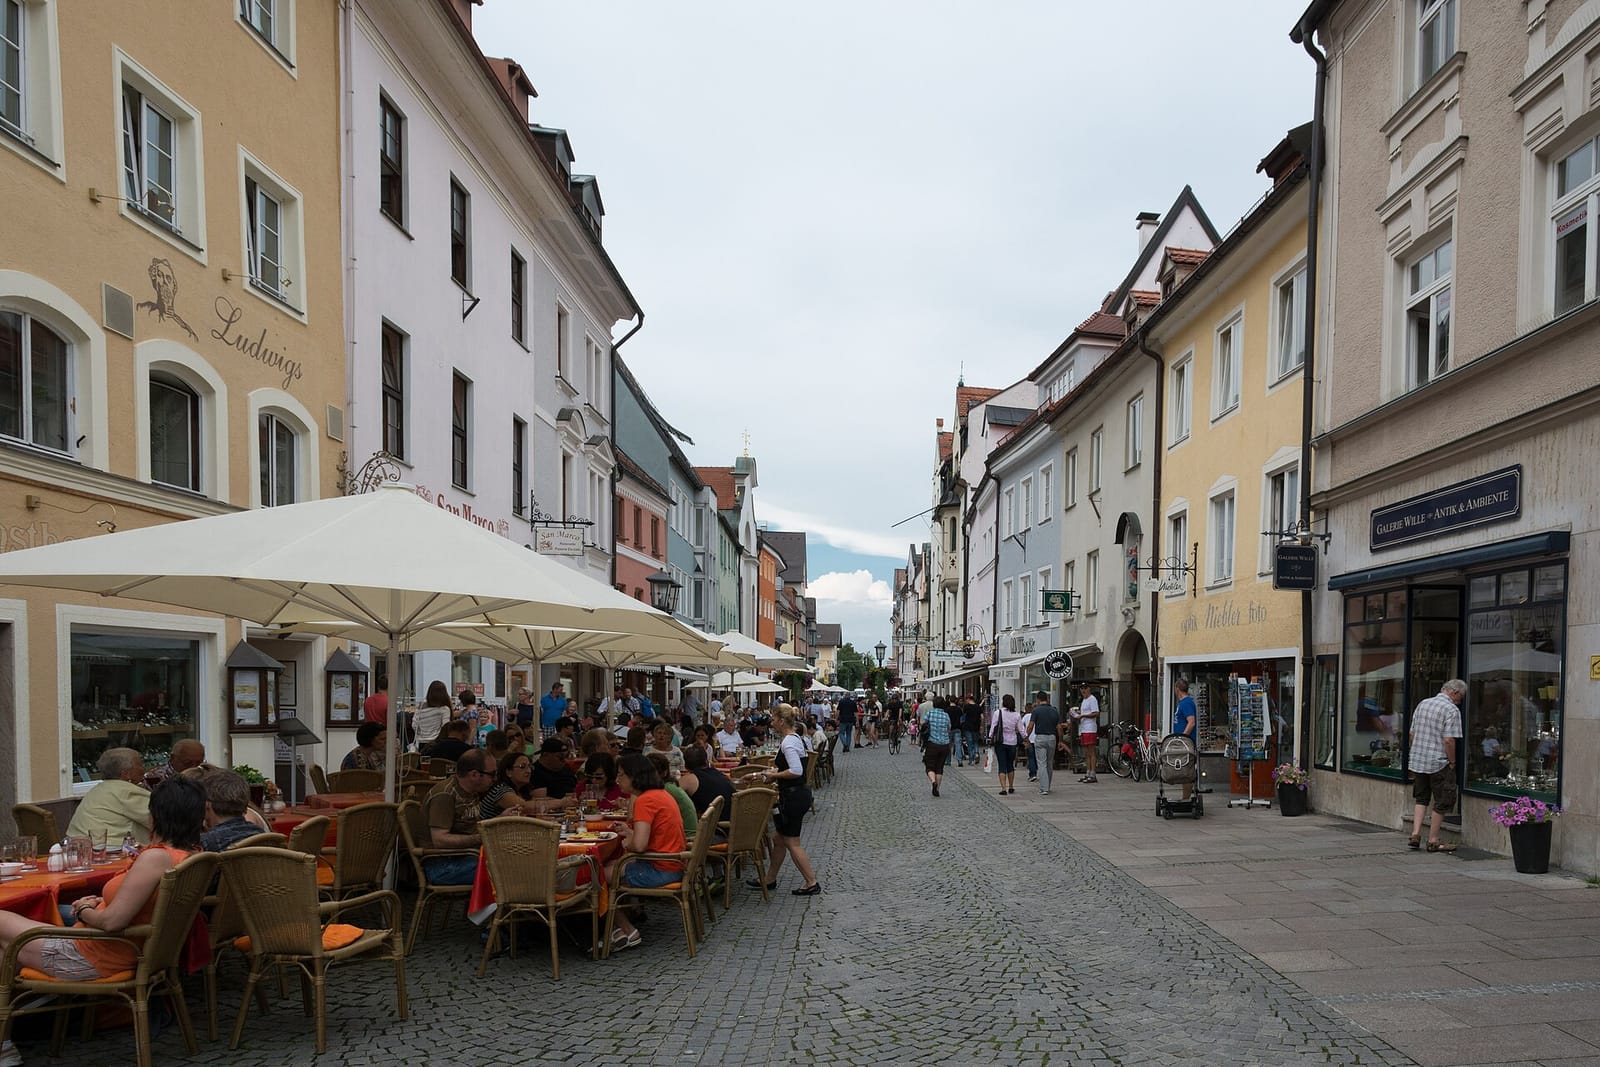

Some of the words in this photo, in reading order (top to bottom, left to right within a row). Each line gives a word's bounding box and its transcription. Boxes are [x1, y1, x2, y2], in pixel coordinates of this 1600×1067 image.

[1556, 210, 1587, 234] Kosmetik
[210, 296, 303, 391] Ludwigs
[437, 493, 460, 517] San
[462, 503, 495, 533] Marco
[1376, 520, 1404, 536] GALERIE
[1403, 513, 1426, 528] WILLE
[1434, 504, 1457, 519] ANTIK
[1458, 502, 1466, 513] &
[1466, 490, 1510, 511] AMBIENTE
[541, 532, 555, 541] San
[557, 531, 581, 541] Marco
[1205, 600, 1241, 630] Niebler
